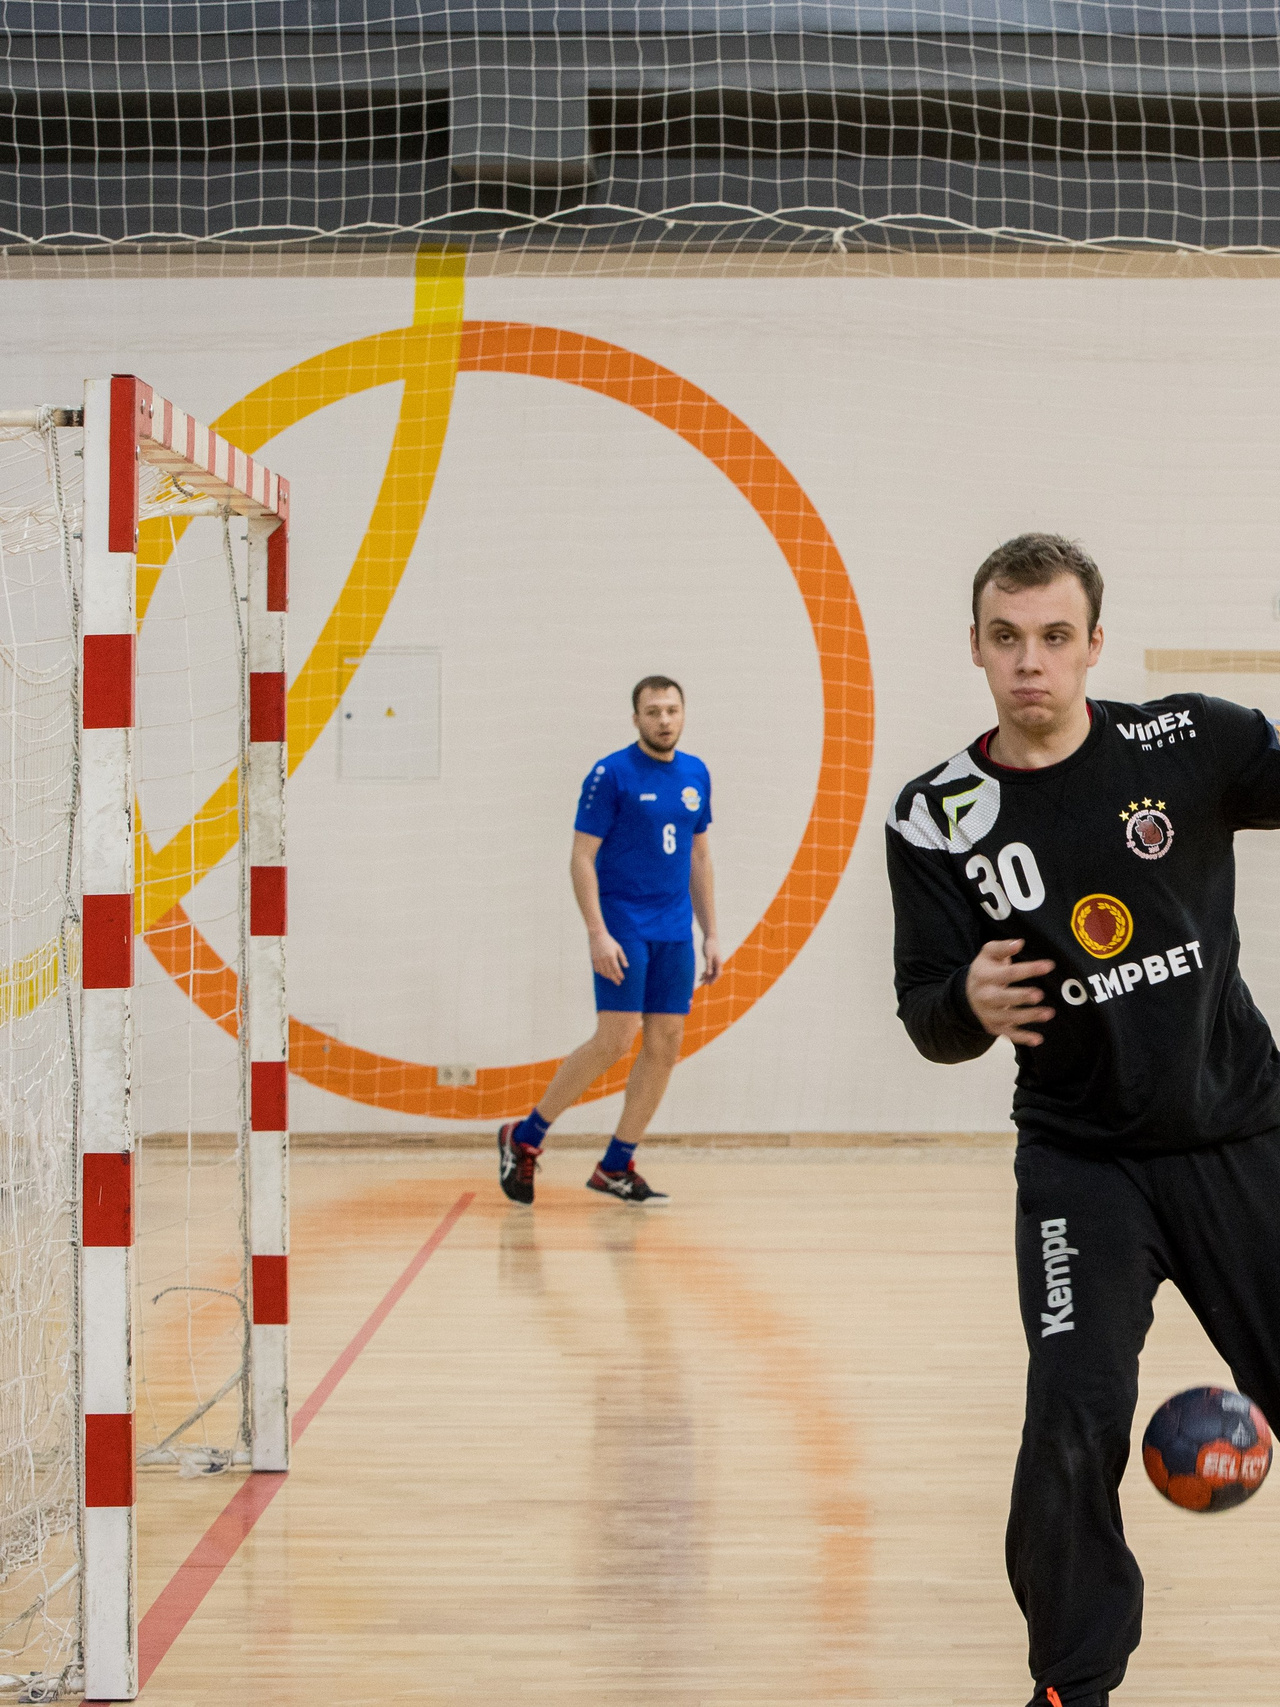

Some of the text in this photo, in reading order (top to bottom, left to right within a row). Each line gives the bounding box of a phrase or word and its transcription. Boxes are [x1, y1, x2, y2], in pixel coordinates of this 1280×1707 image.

[1116, 710, 1194, 741] VinEx
[1141, 730, 1196, 751] media
[662, 823, 676, 854] 6
[965, 842, 1046, 921] 30
[1061, 940, 1203, 1006] OIMPBET
[1040, 1218, 1079, 1338] Kempa
